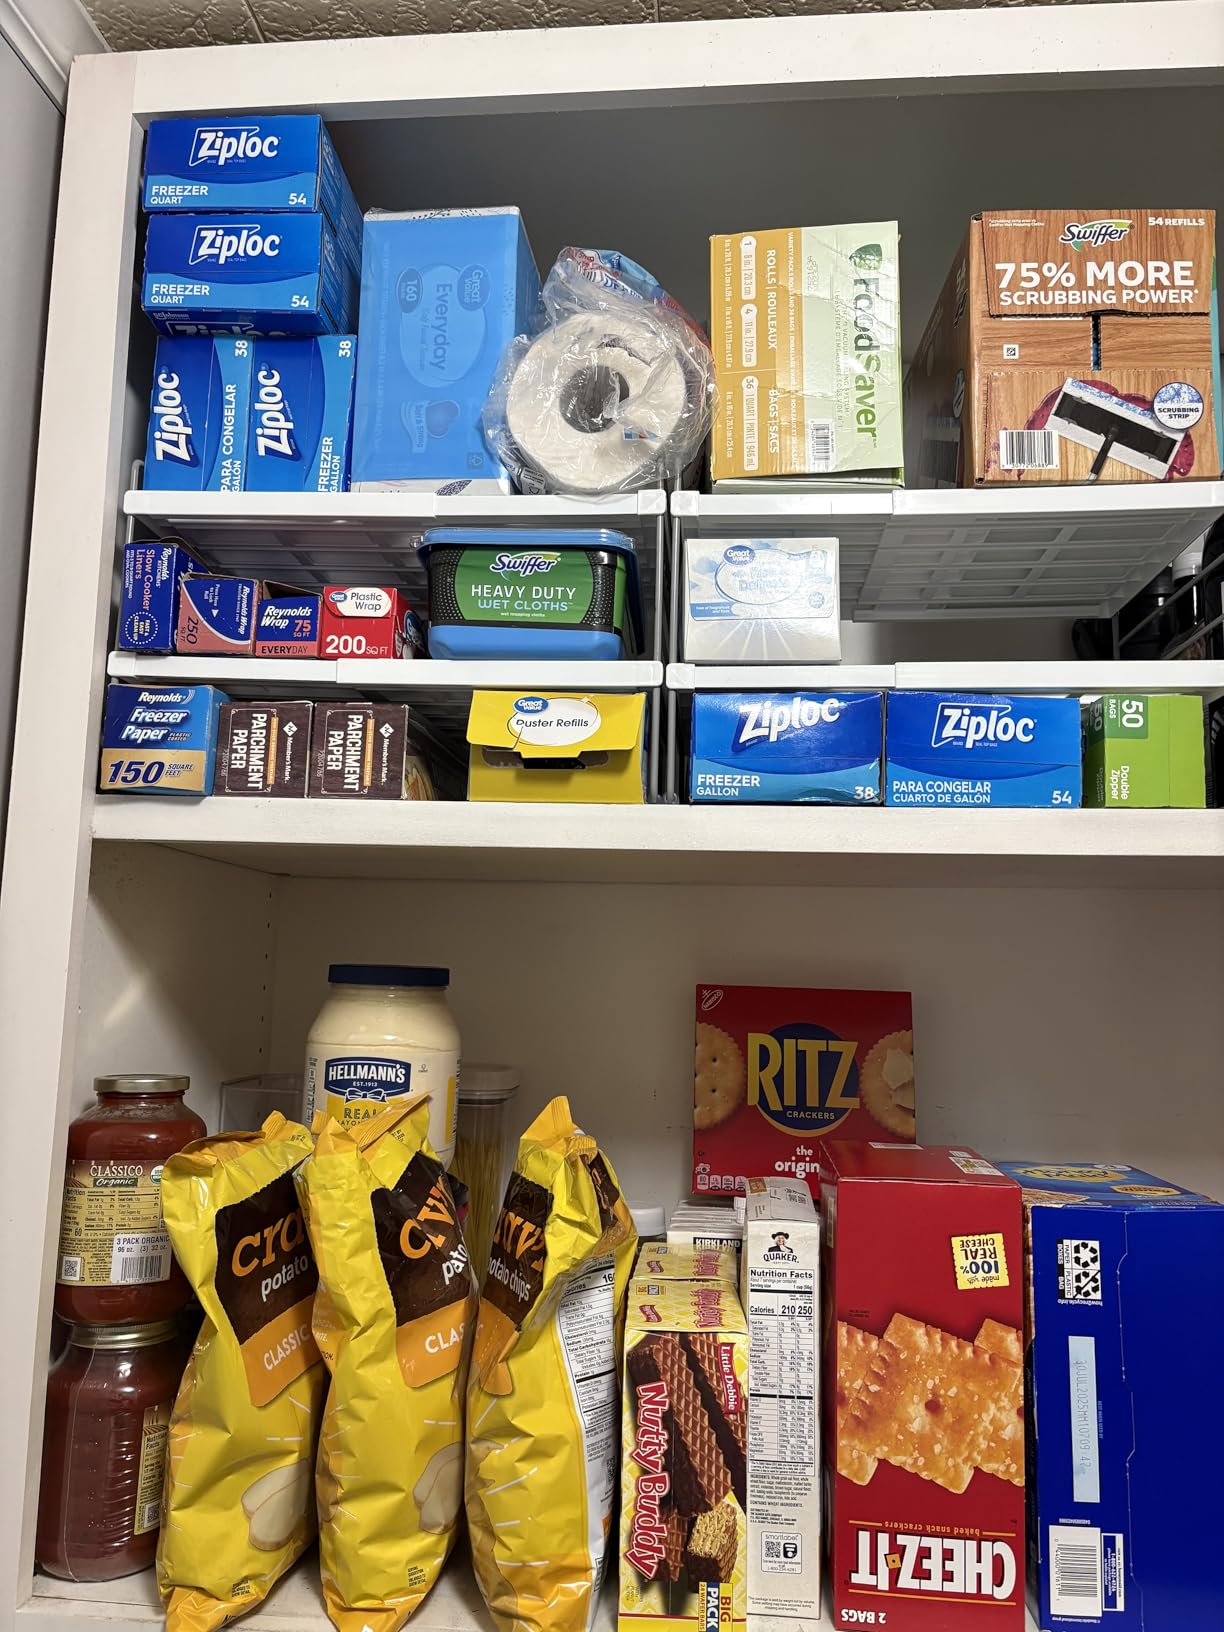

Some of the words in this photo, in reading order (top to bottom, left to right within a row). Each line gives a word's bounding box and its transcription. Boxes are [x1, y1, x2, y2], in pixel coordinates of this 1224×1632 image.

[197, 132, 279, 166] Ziploc
[152, 185, 209, 196] FREEZER
[288, 193, 307, 205] 54
[150, 196, 183, 205] QUART
[1148, 216, 1164, 227] 54
[1165, 217, 1205, 227] REFILLS
[1058, 221, 1129, 247] Swiffer
[197, 229, 281, 265] Ziploc
[766, 249, 777, 285] ROLLS
[995, 261, 1076, 288] 75%
[1085, 260, 1195, 287] MORE
[152, 283, 210, 296] FREEZER
[406, 279, 419, 303] 160
[470, 270, 484, 304] Great
[150, 295, 184, 305] QUART
[290, 295, 310, 308] 54
[999, 289, 1117, 306] SCRUBBING
[429, 282, 453, 372] Everyday
[767, 292, 778, 350] ROULEAUX
[235, 339, 249, 358] 38
[338, 339, 352, 358] 38
[853, 277, 882, 438] FoodSaver
[745, 378, 754, 389] 36
[254, 369, 295, 457] Ziploc
[745, 397, 755, 417] QUART
[768, 389, 779, 419] BAGS
[1157, 406, 1200, 415] SCRUBBING
[153, 372, 193, 462] Ziploc
[222, 383, 237, 456] CONGELAR
[745, 422, 755, 440] PINTE
[769, 425, 779, 454] SACS
[745, 445, 755, 457] 946
[317, 435, 334, 493] FREEZER
[220, 458, 233, 493] PARA
[329, 455, 341, 493] GALLON
[134, 549, 145, 580] Liners
[145, 549, 155, 572] Slow
[161, 547, 172, 581] Reynolds
[490, 552, 559, 577] Swiffer
[142, 574, 154, 611] Cooker
[240, 585, 251, 616] Reynolds
[350, 591, 383, 602] Plastic
[471, 584, 526, 599] HEAVY
[532, 586, 577, 600] DUTY
[263, 605, 313, 618] Reynolds
[355, 601, 382, 613] Wrap
[477, 599, 510, 610] WET
[514, 600, 569, 611] CLOTHS
[186, 615, 199, 645] 250
[238, 616, 249, 635] Wrap
[260, 615, 290, 630] Wrap
[294, 620, 312, 633] 75
[261, 645, 309, 655] EVERYDAY
[325, 635, 367, 655] 200
[366, 647, 379, 655] SQ
[379, 645, 389, 655] FT
[138, 691, 182, 705] Reynolds
[517, 699, 543, 707] Great
[130, 707, 188, 723] Freezer
[1108, 699, 1117, 719] BAGS
[1121, 699, 1144, 729] 50
[515, 718, 554, 728] Duster
[556, 718, 589, 728] Refills
[738, 696, 841, 743] Ziploc
[941, 707, 1035, 749] Ziploc
[121, 725, 169, 744] Paper
[230, 729, 249, 769] PAPER
[247, 713, 268, 790] PARCHMENT
[284, 736, 294, 765] Member's
[326, 730, 345, 771] PAPER
[343, 714, 364, 791] PARCHMENT
[381, 738, 390, 763] Member's
[108, 760, 166, 785] 150
[165, 769, 181, 777] FEET
[167, 763, 195, 771] SQUARE
[283, 765, 291, 781] Mark
[381, 763, 389, 782] Mark
[697, 774, 761, 787] FREEZER
[892, 780, 924, 793] PARA
[925, 780, 992, 793] CONGELAR
[1109, 769, 1120, 801] Zipper
[1120, 765, 1131, 801] Double
[696, 787, 740, 797] GALLON
[853, 786, 875, 799] 38
[892, 793, 935, 804] CUARTO
[936, 794, 951, 804] DE
[953, 792, 991, 804] GALÓN
[1051, 790, 1073, 805] 54
[328, 1063, 406, 1084] HELLMANN'S
[747, 1032, 861, 1111] RITZ
[786, 1110, 836, 1120] CRACKERS
[795, 1145, 814, 1156] the
[89, 1163, 144, 1178] CLASSICO
[95, 1178, 135, 1187] Organic
[74, 1227, 82, 1237] 60
[116, 1237, 121, 1246] 3
[122, 1236, 140, 1246] PACK
[141, 1234, 170, 1245] ORGANIC
[695, 1238, 741, 1250] KIRKLAND
[959, 1237, 995, 1249] CHEESE
[763, 1252, 798, 1264] QUAKER
[960, 1246, 998, 1260] REAL
[750, 1269, 787, 1278] Nutrition
[790, 1270, 813, 1279] Facts
[959, 1260, 999, 1275] 100%
[260, 1254, 310, 1302] potato
[509, 1269, 532, 1303] chips
[981, 1274, 1000, 1284] made
[750, 1305, 775, 1314] Calories
[781, 1305, 796, 1314] 210
[797, 1306, 813, 1315] 250
[1057, 1298, 1103, 1307] how2recycle.info
[263, 1323, 311, 1372] CLASSIC
[719, 1345, 734, 1371] Little
[722, 1370, 736, 1411] Debbie
[632, 1382, 669, 1474] Nutty
[625, 1472, 670, 1581] Buddy
[884, 1520, 923, 1532] crackers
[925, 1524, 951, 1534] snack
[953, 1527, 981, 1537] baked
[765, 1533, 799, 1541] smartlabel
[707, 1586, 720, 1630] PACK
[720, 1592, 732, 1623] BIG
[840, 1608, 876, 1624] BAGS
[877, 1611, 887, 1624] 2
